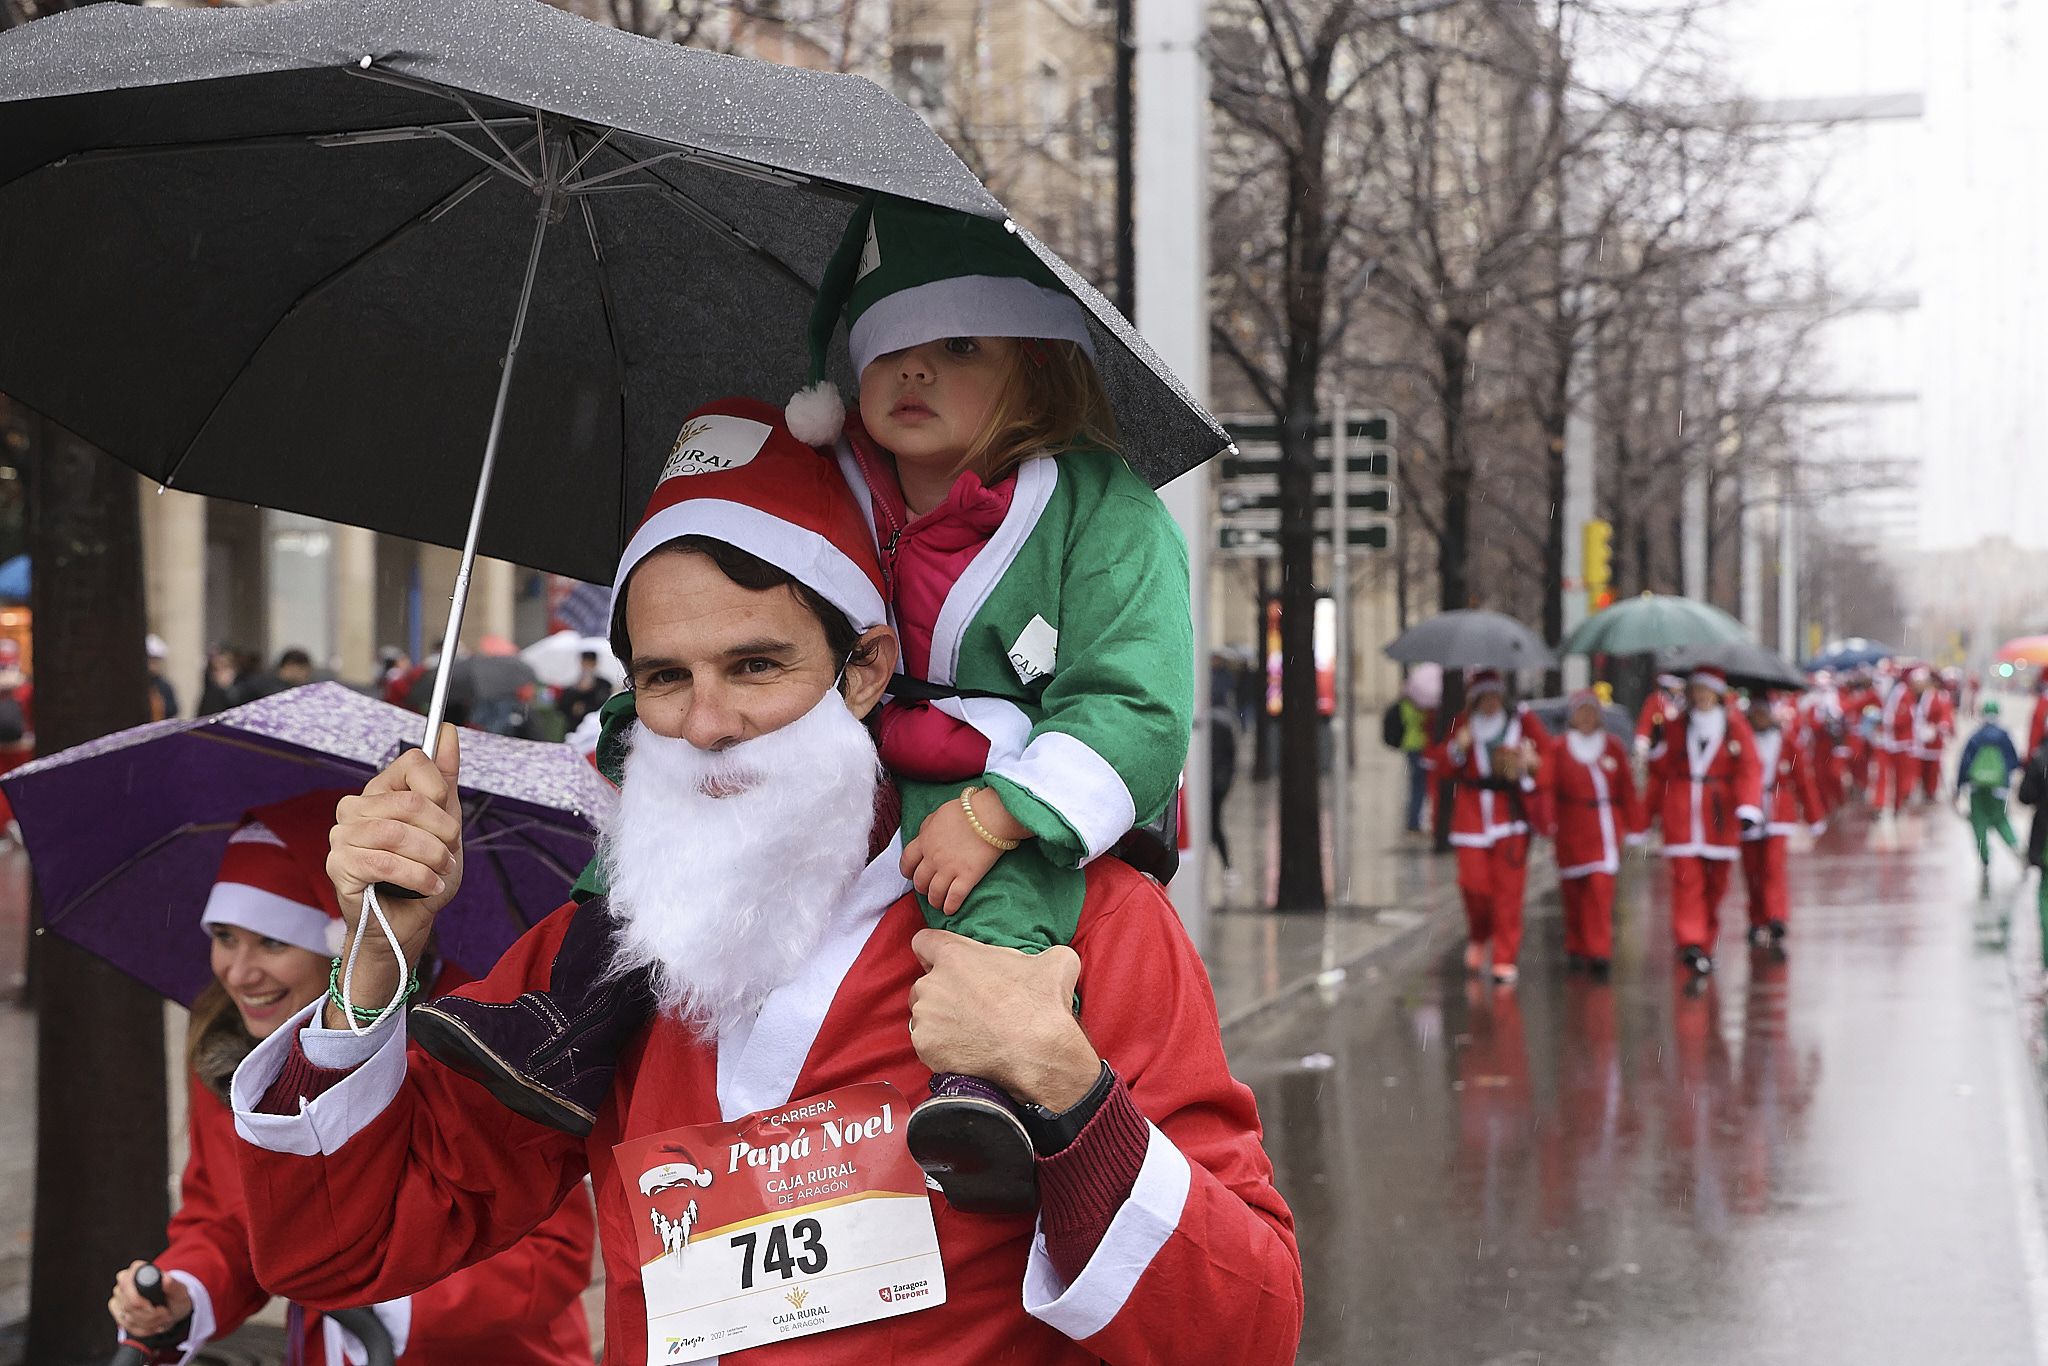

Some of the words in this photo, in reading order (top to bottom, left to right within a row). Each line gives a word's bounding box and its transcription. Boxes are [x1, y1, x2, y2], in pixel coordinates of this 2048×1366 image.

[770, 1100, 836, 1127] CARRERA
[727, 1127, 811, 1175] Papá
[821, 1103, 895, 1152] Noel
[766, 1174, 805, 1193] CAJA
[807, 1161, 857, 1184] RURAL
[778, 1194, 794, 1205] DE
[797, 1180, 849, 1200] ARAGÓN
[730, 1217, 828, 1290] 743
[893, 1280, 928, 1293] Zaragoza
[895, 1289, 929, 1301] DEPORTE
[772, 1313, 796, 1325] CAJA
[797, 1305, 830, 1320] RURAL
[779, 1325, 790, 1333] DE
[792, 1317, 825, 1330] ARAGÓN
